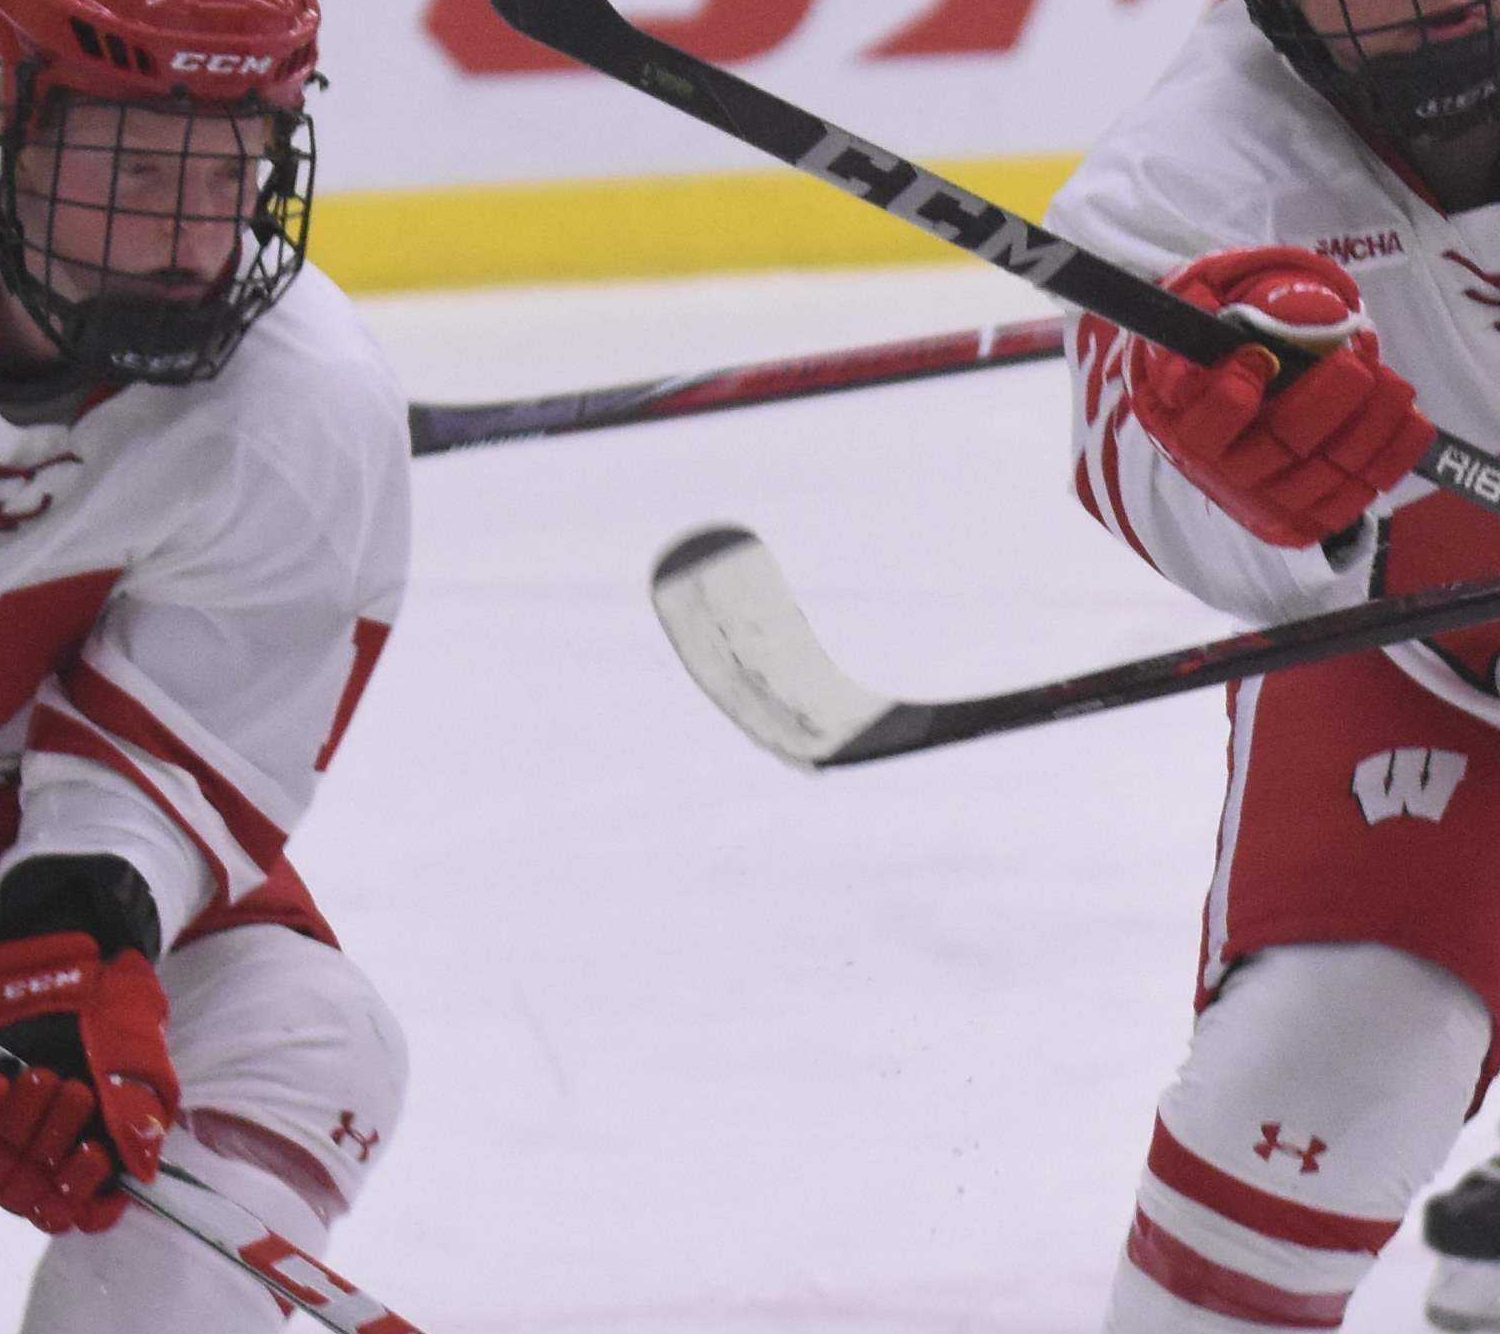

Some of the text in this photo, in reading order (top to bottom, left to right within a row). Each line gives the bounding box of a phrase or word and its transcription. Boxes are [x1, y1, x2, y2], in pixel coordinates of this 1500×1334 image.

[170, 51, 274, 75] CCM
[796, 124, 1080, 287] CCM
[1351, 746, 1469, 826] W
[3, 968, 82, 1001] CCM
